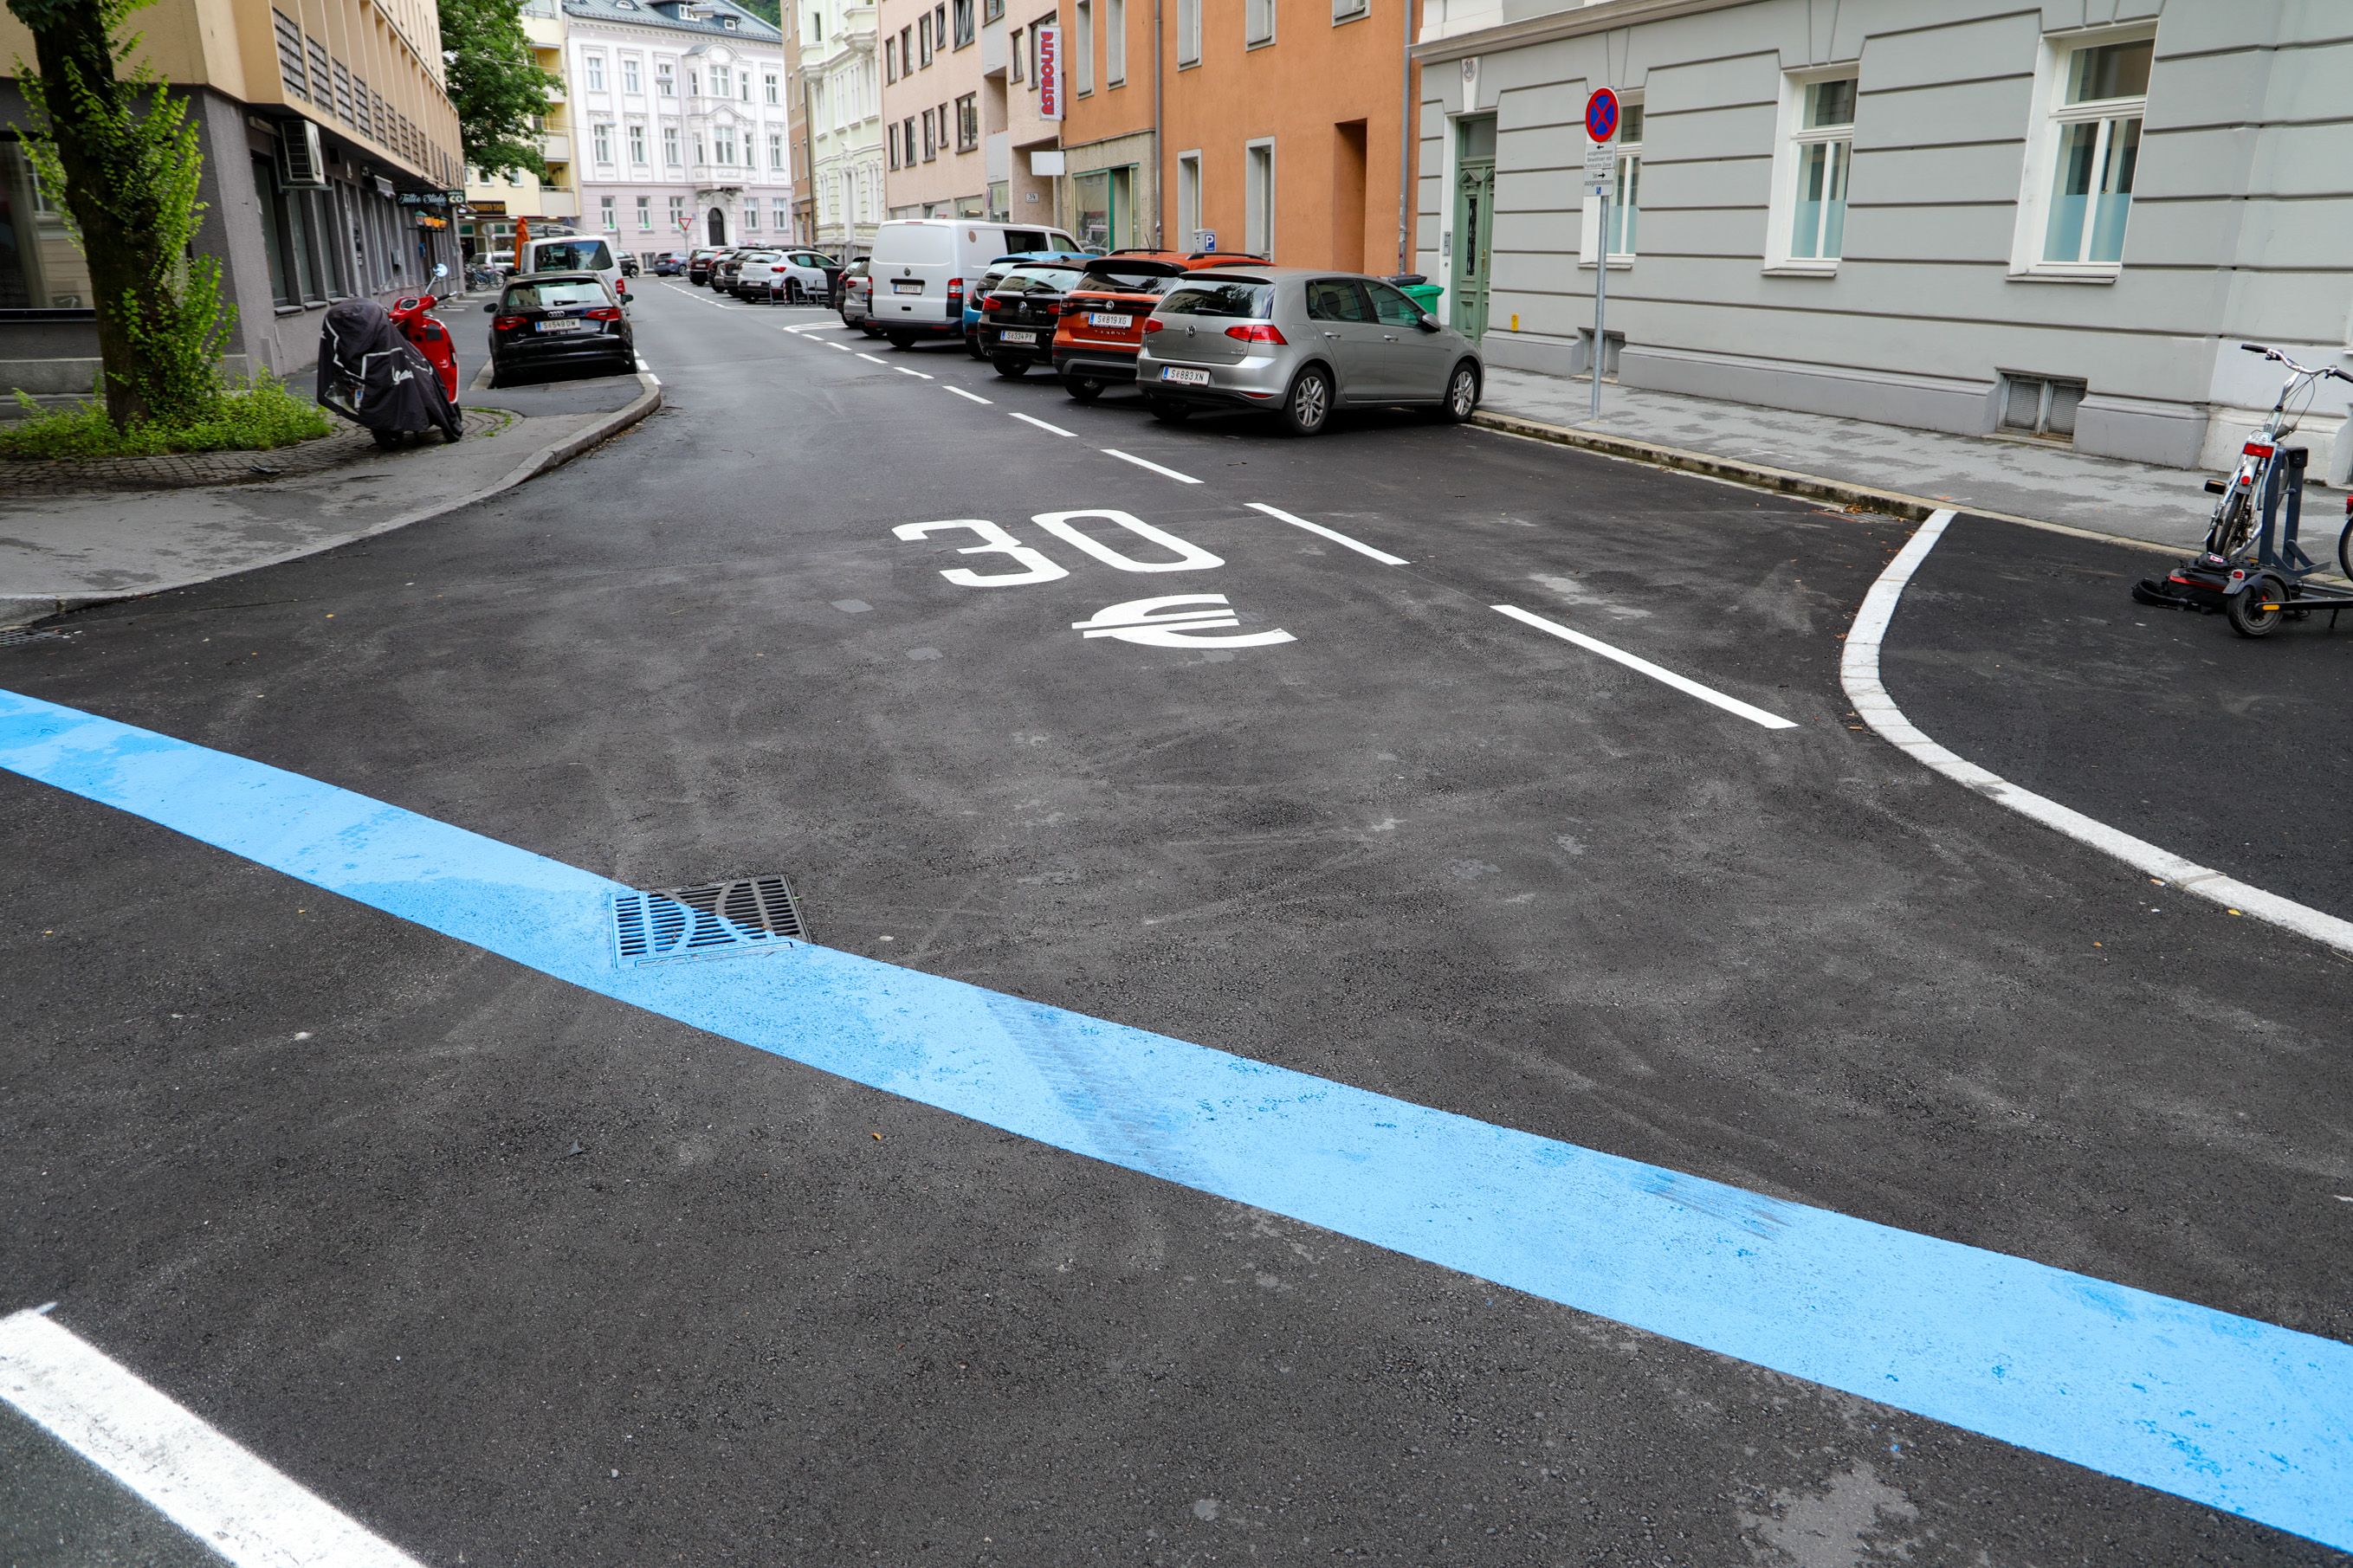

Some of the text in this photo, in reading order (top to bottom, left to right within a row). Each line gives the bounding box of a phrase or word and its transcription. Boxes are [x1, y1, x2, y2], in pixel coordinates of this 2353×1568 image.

[423, 192, 447, 204] Studio
[1206, 235, 1214, 248] P
[891, 509, 1225, 587] 30
